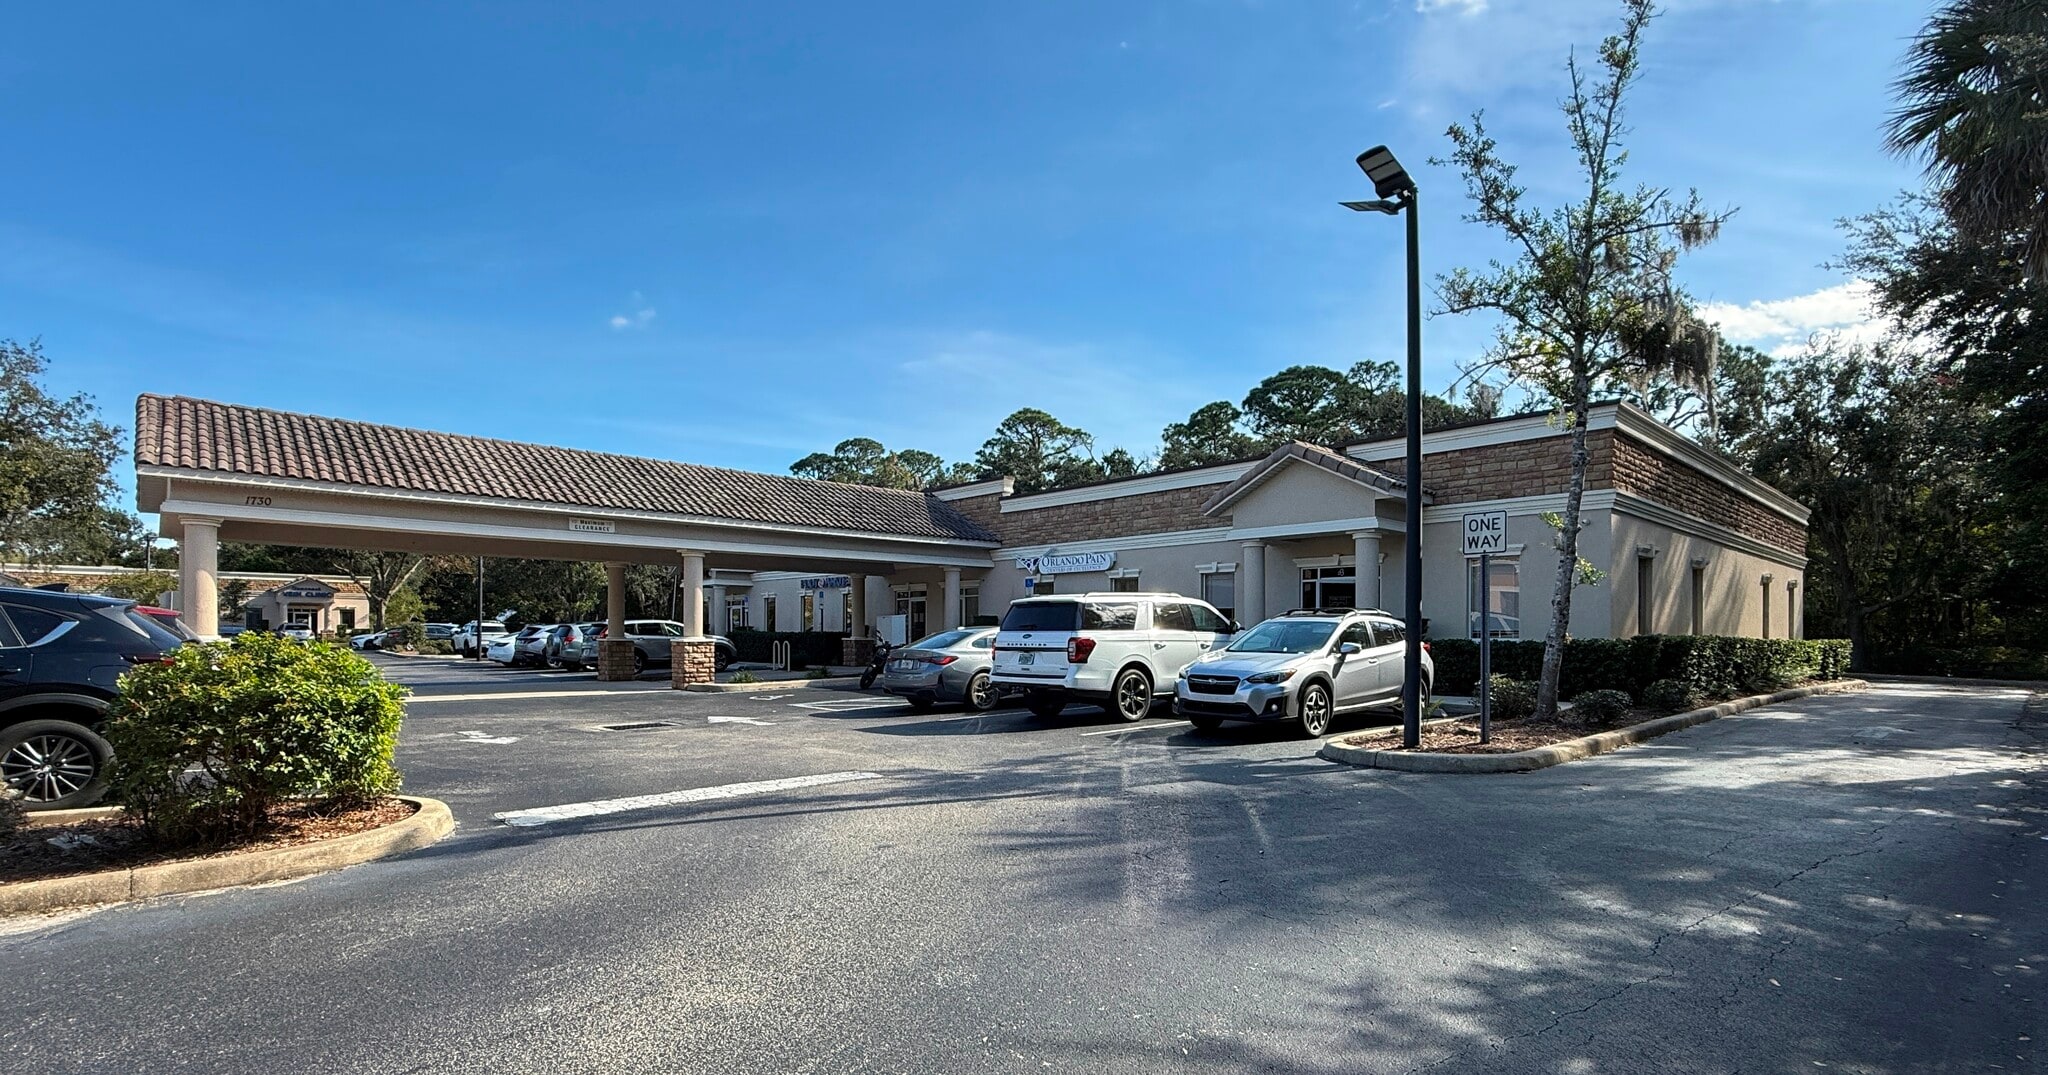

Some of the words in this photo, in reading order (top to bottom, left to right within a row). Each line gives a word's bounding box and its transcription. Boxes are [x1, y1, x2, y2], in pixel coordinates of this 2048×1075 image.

[245, 496, 272, 506] 1730
[1469, 517, 1501, 532] ONE
[1467, 534, 1502, 549] WAY
